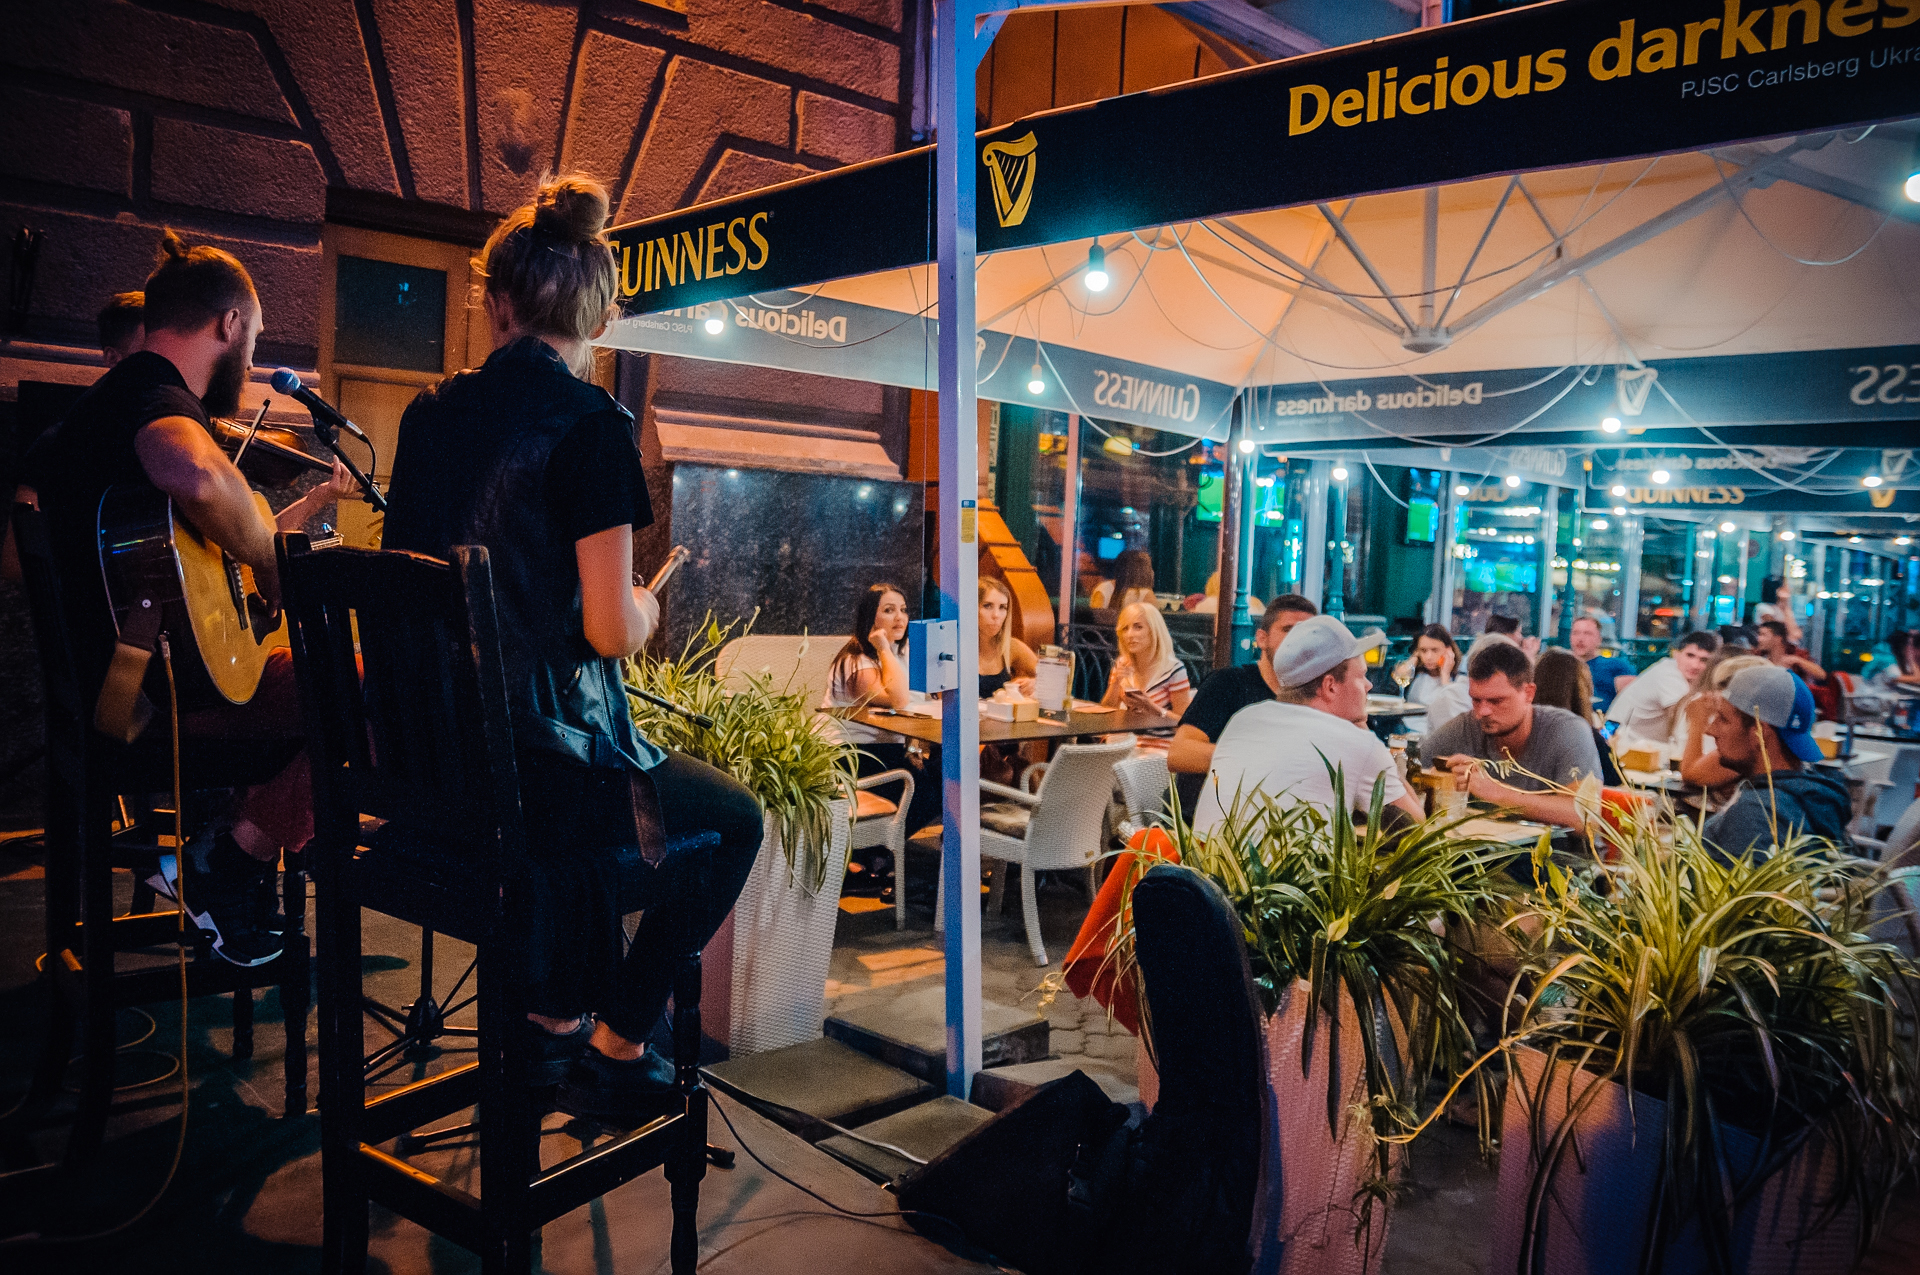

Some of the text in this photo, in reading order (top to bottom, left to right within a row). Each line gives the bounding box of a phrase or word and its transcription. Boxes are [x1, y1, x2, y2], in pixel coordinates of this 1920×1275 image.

[1288, 48, 1568, 136] Delicious
[1682, 74, 1739, 98] PJSC
[1748, 57, 1859, 88] Carlsberg
